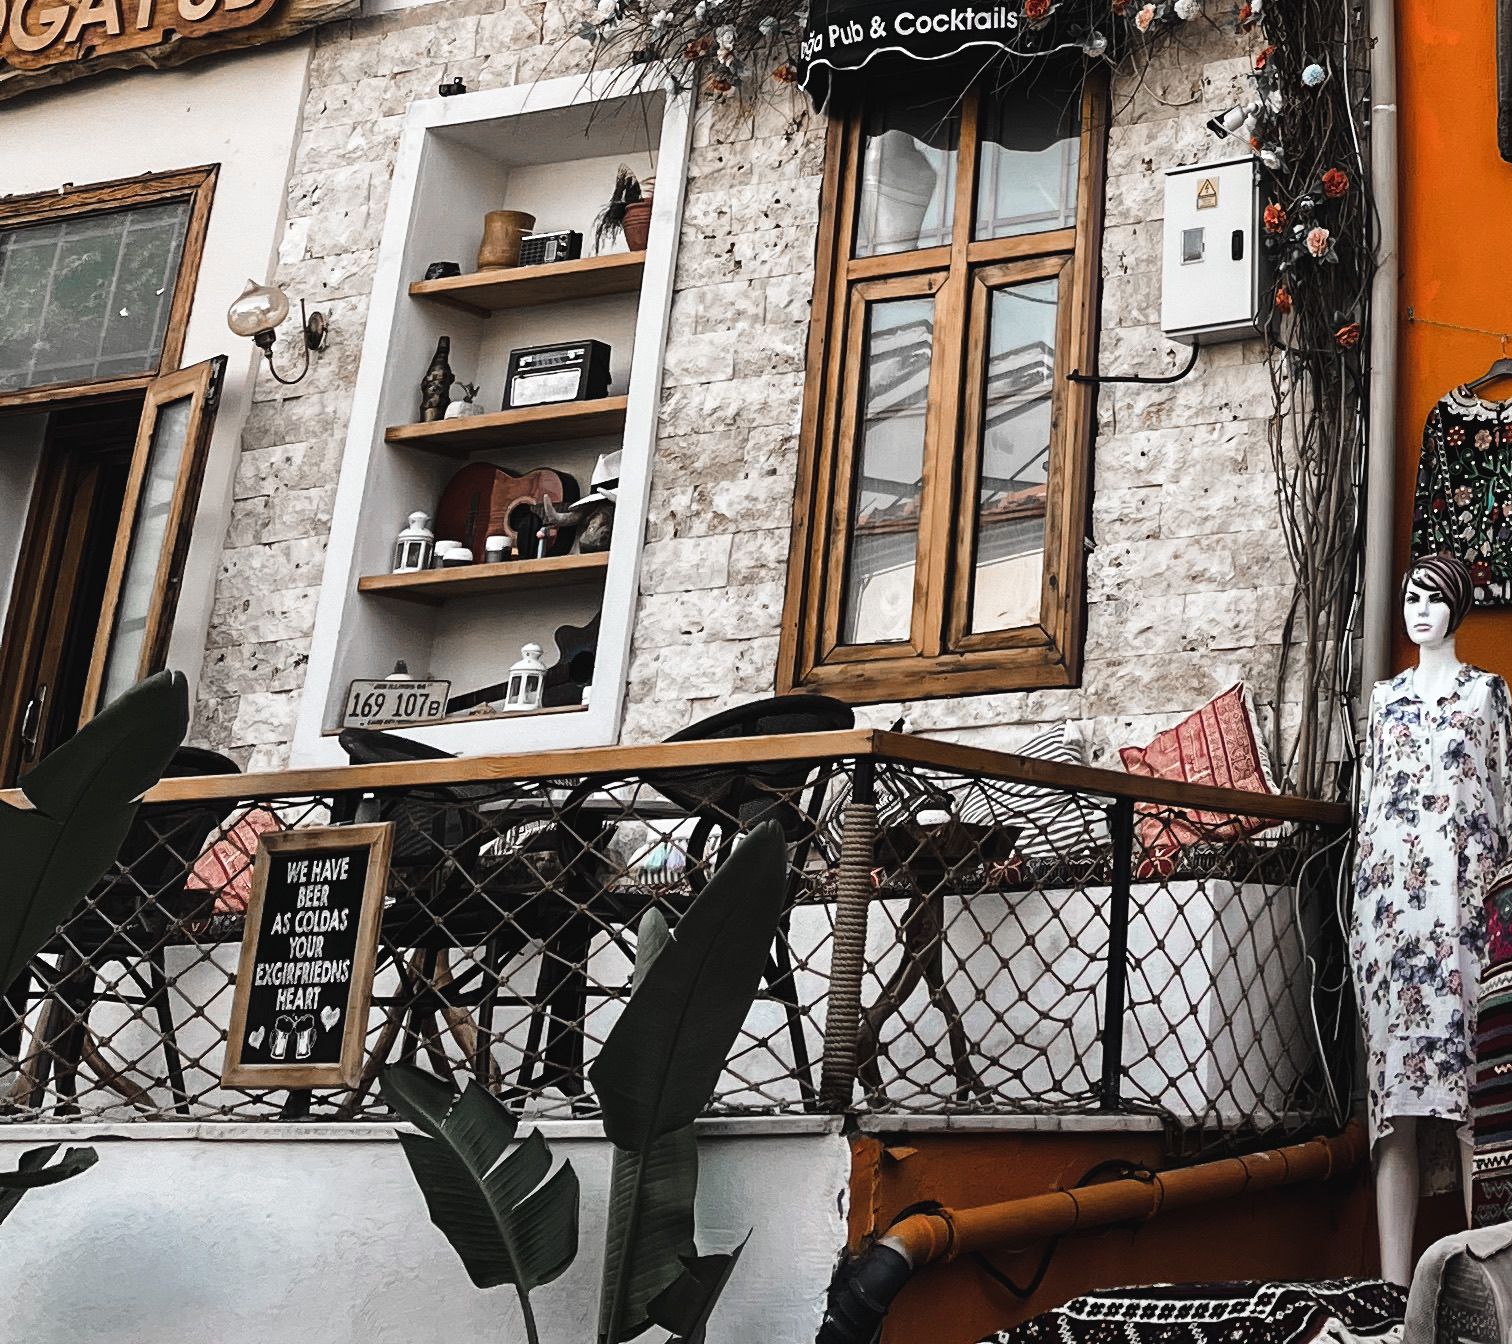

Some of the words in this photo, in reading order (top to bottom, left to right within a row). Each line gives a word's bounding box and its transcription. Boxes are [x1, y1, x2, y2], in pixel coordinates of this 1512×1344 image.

[828, 20, 864, 48] Pub
[869, 15, 887, 39] &
[894, 6, 1018, 36] Cocktails
[348, 692, 386, 718] 169
[287, 860, 309, 884] WE
[310, 857, 350, 882] HAVE
[296, 884, 330, 909] BEER
[270, 912, 292, 935] AS
[289, 935, 324, 959] YOUR
[275, 986, 321, 1011] HEART
